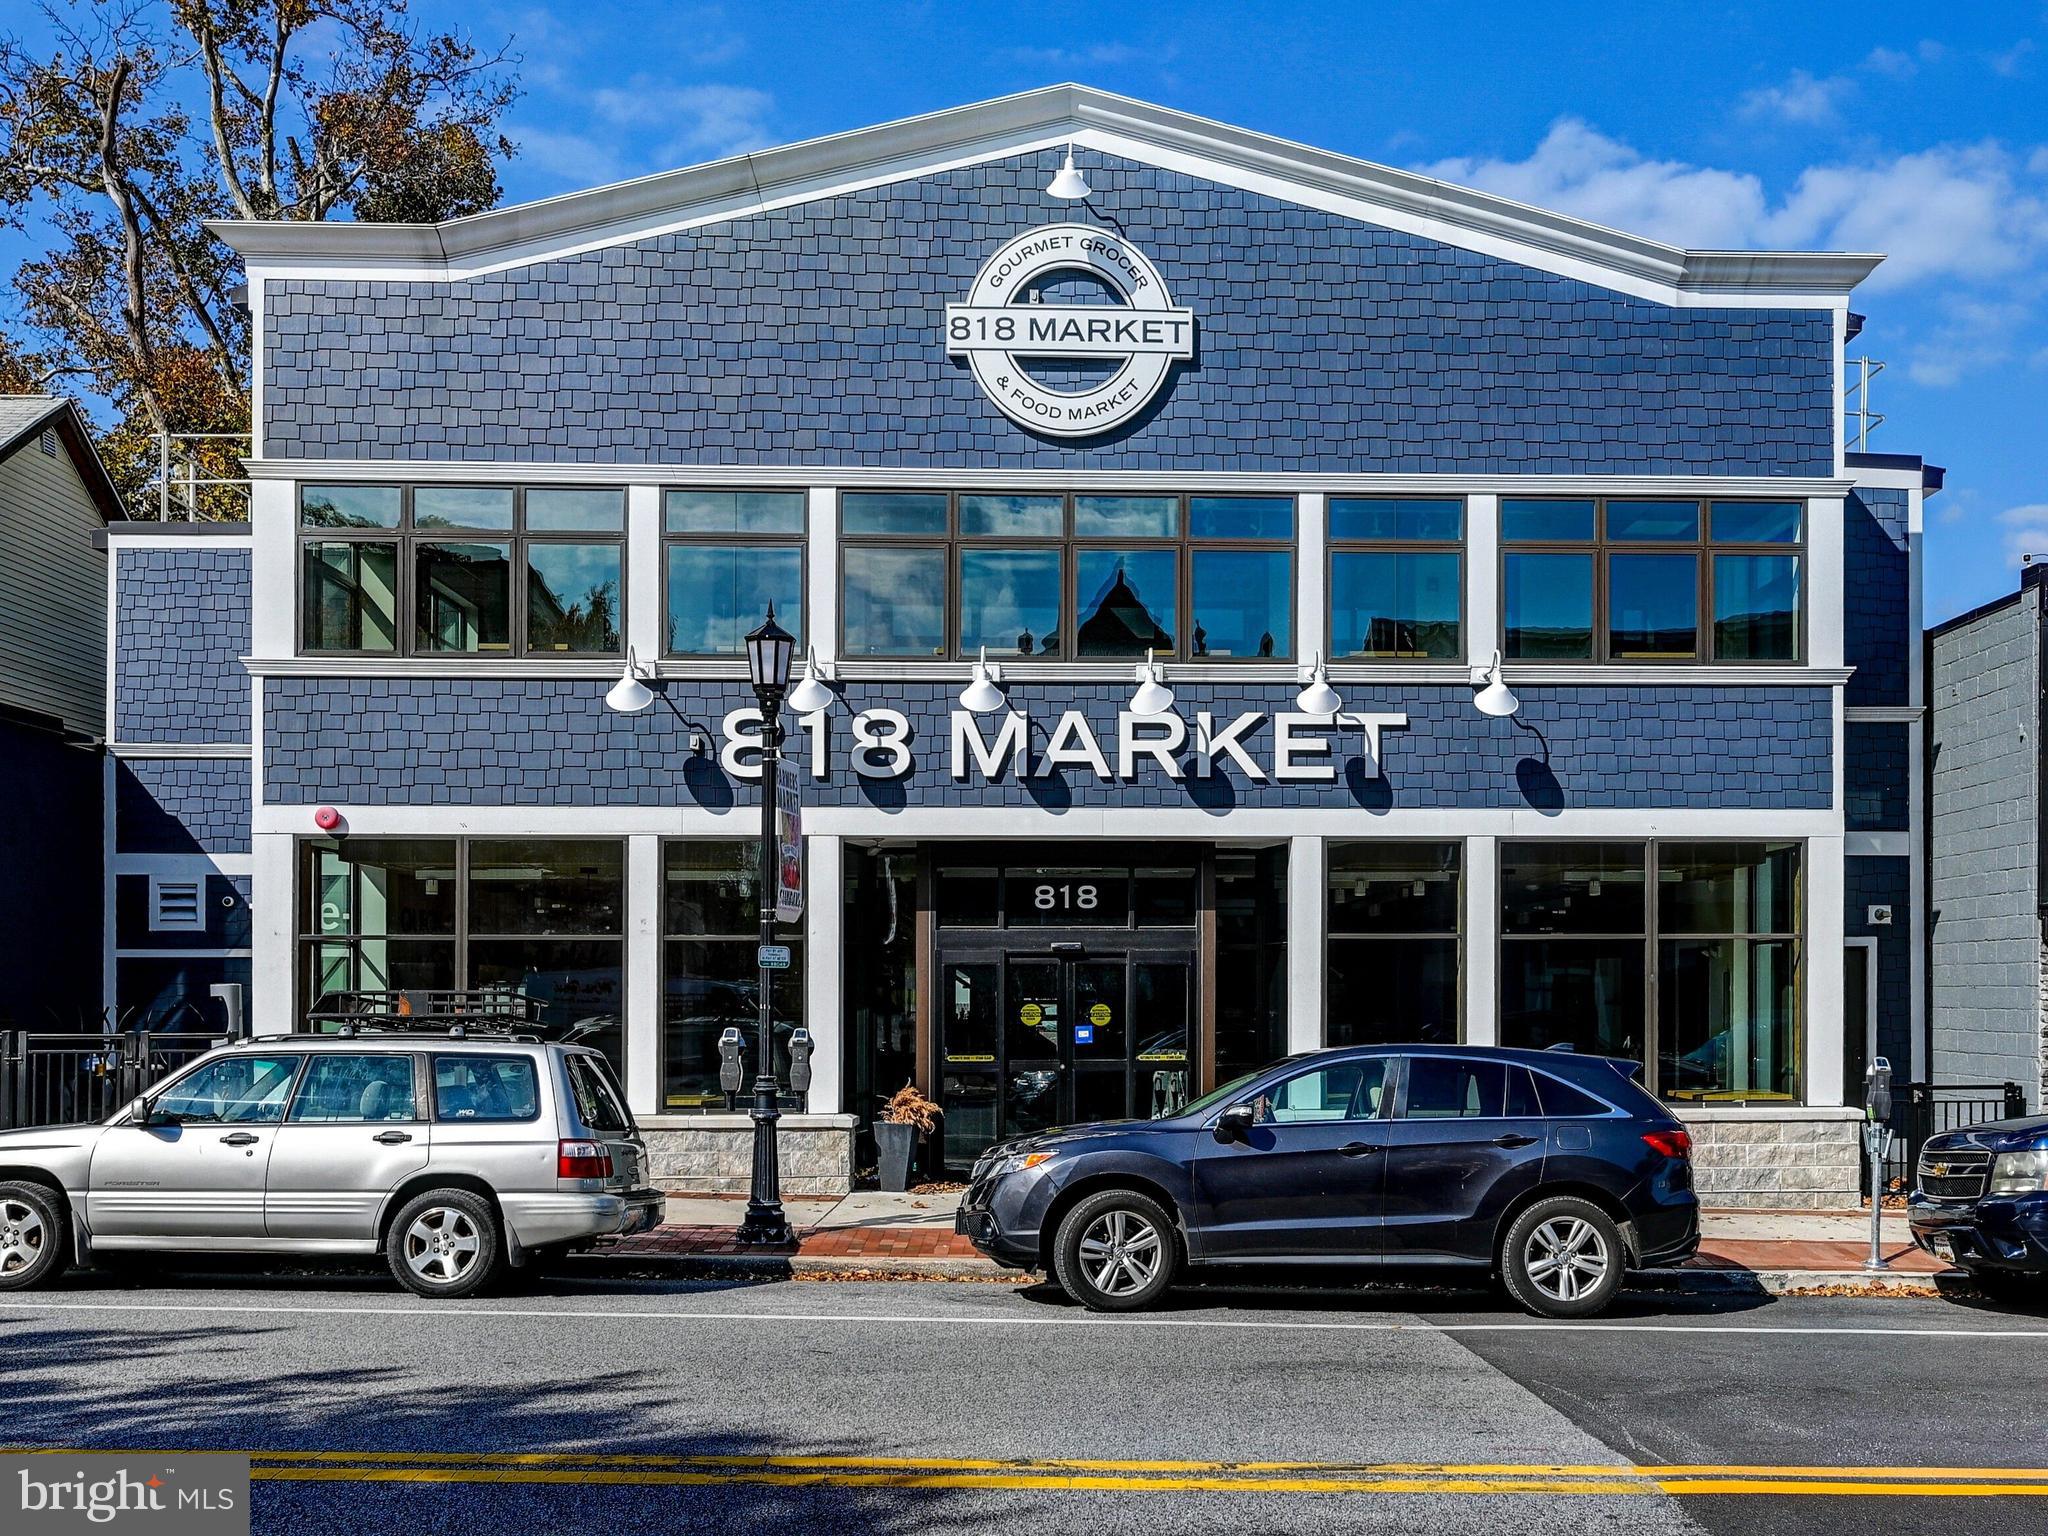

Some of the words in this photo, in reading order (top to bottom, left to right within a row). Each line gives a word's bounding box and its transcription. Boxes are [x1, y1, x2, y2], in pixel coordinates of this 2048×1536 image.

[990, 236, 1073, 288] GOURMET
[1080, 237, 1149, 290] GROCER
[949, 316, 1016, 341] 818
[1029, 317, 1190, 344] MARKET
[996, 374, 1010, 391] &
[1010, 387, 1062, 419] FOOD
[1068, 377, 1139, 421] MARKET
[721, 707, 911, 779] 818
[951, 710, 1405, 778] MARKET
[1034, 884, 1098, 909] 818
